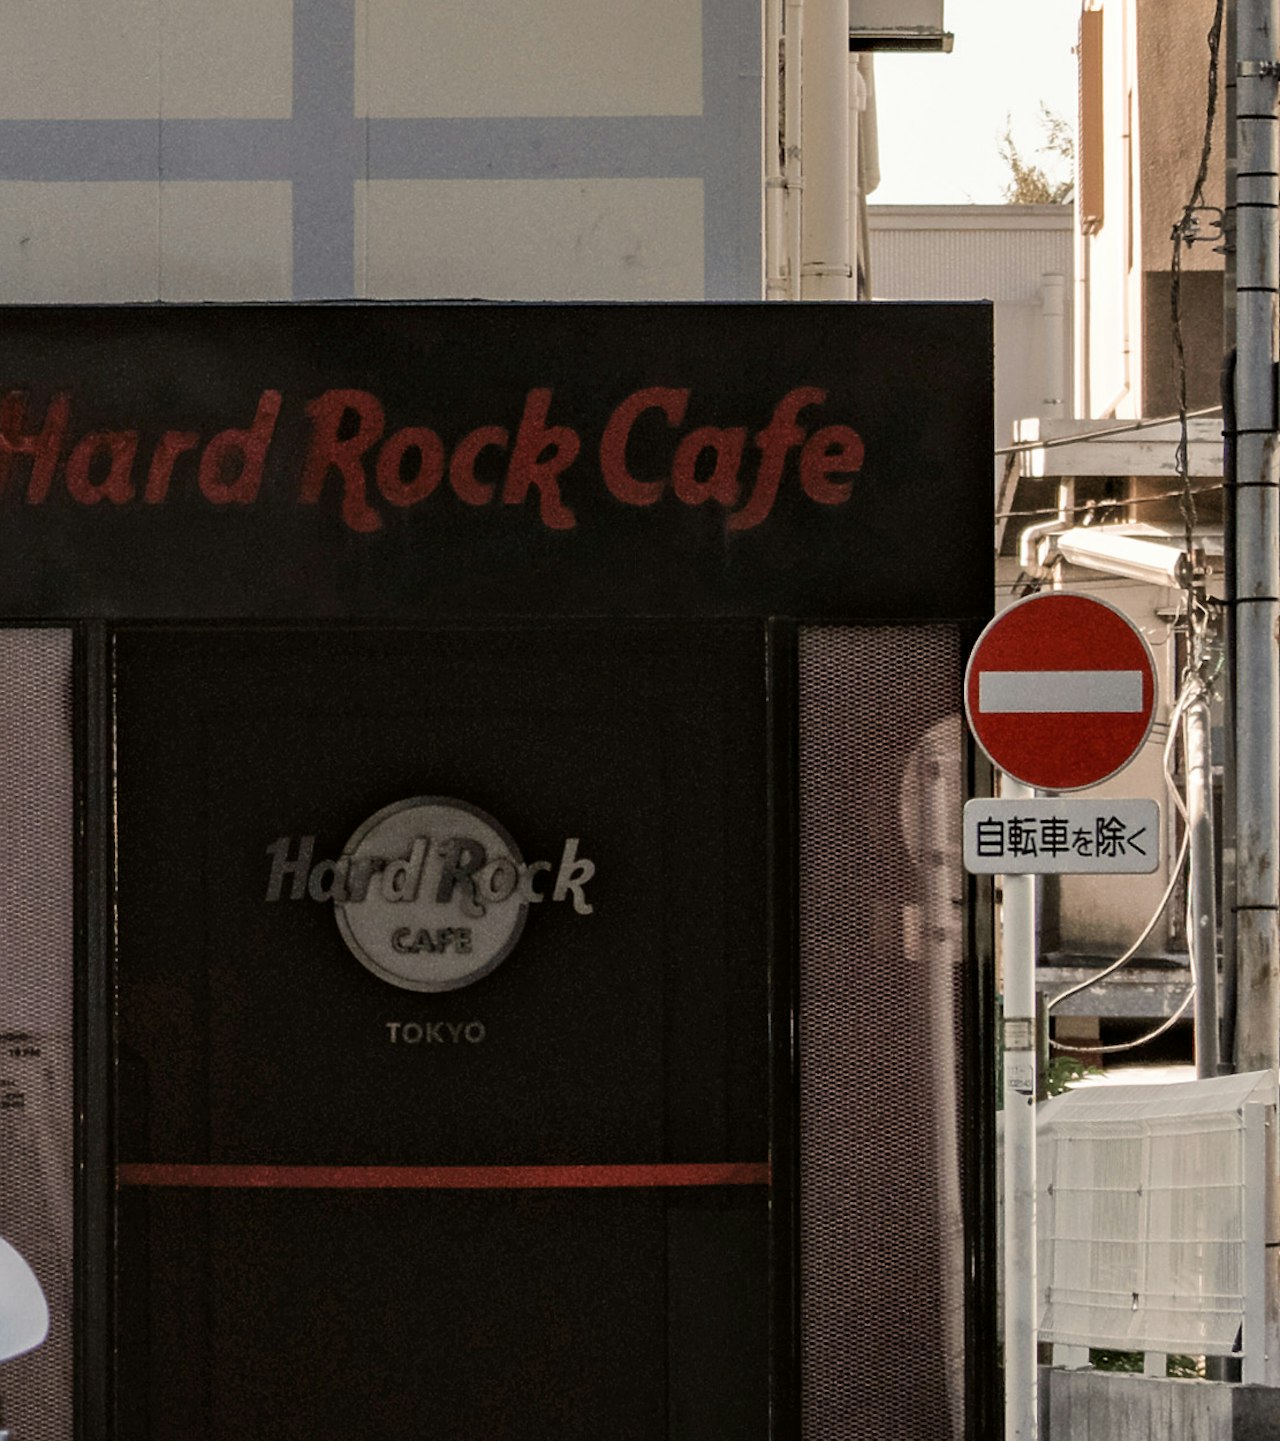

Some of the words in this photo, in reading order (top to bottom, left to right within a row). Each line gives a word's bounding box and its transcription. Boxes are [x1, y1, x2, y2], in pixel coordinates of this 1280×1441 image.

[300, 386, 581, 532] Rock
[600, 385, 866, 531] Cafe
[976, 816, 1147, 858] 自転車を除く
[264, 835, 429, 904] Hard
[436, 836, 596, 918] Rock
[391, 926, 474, 954] CAFE
[386, 1021, 486, 1044] TOKYO
